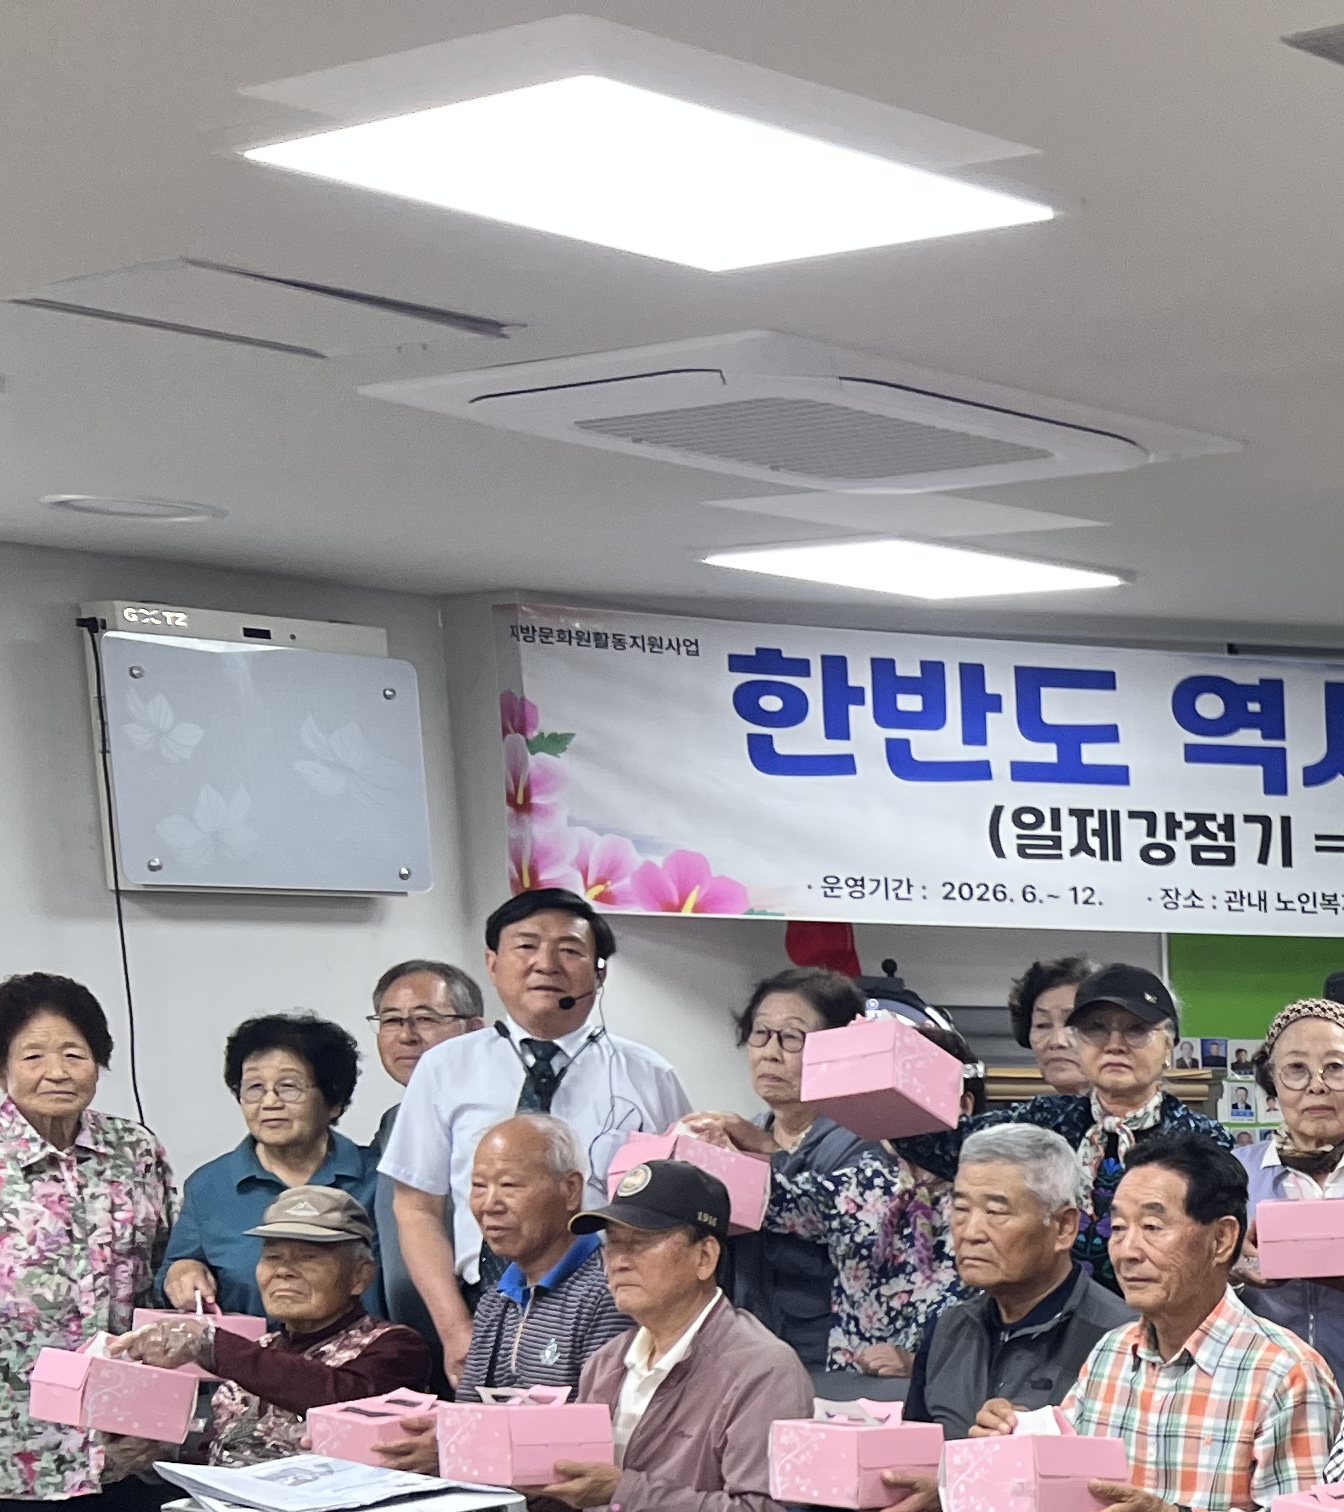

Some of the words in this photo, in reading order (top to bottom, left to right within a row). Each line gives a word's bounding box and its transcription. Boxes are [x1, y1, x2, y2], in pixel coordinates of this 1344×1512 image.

[727, 646, 1130, 786] 한반도
[988, 804, 1294, 869] (일제강점기
[820, 874, 914, 901] 운영기간
[941, 881, 1015, 903] 2026.
[1159, 887, 1205, 911] 장소
[1223, 889, 1268, 913] 관내
